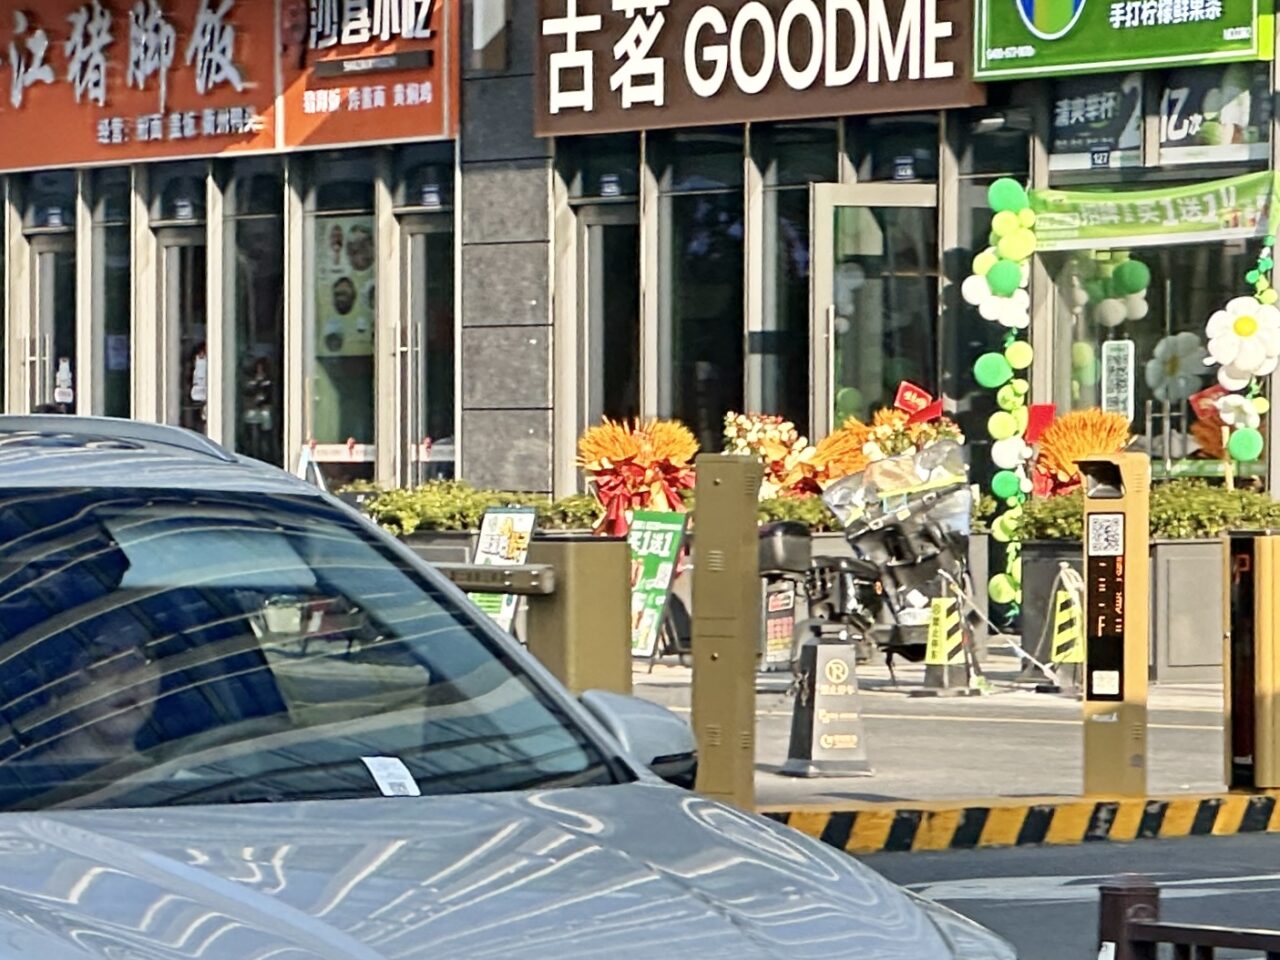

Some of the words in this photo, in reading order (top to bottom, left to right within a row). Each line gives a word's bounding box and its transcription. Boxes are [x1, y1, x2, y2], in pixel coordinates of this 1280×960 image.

[1109, 0, 1223, 29] 手打柠檬鲜果茶
[542, 0, 670, 114] 古茗
[683, 0, 955, 98] GOODME
